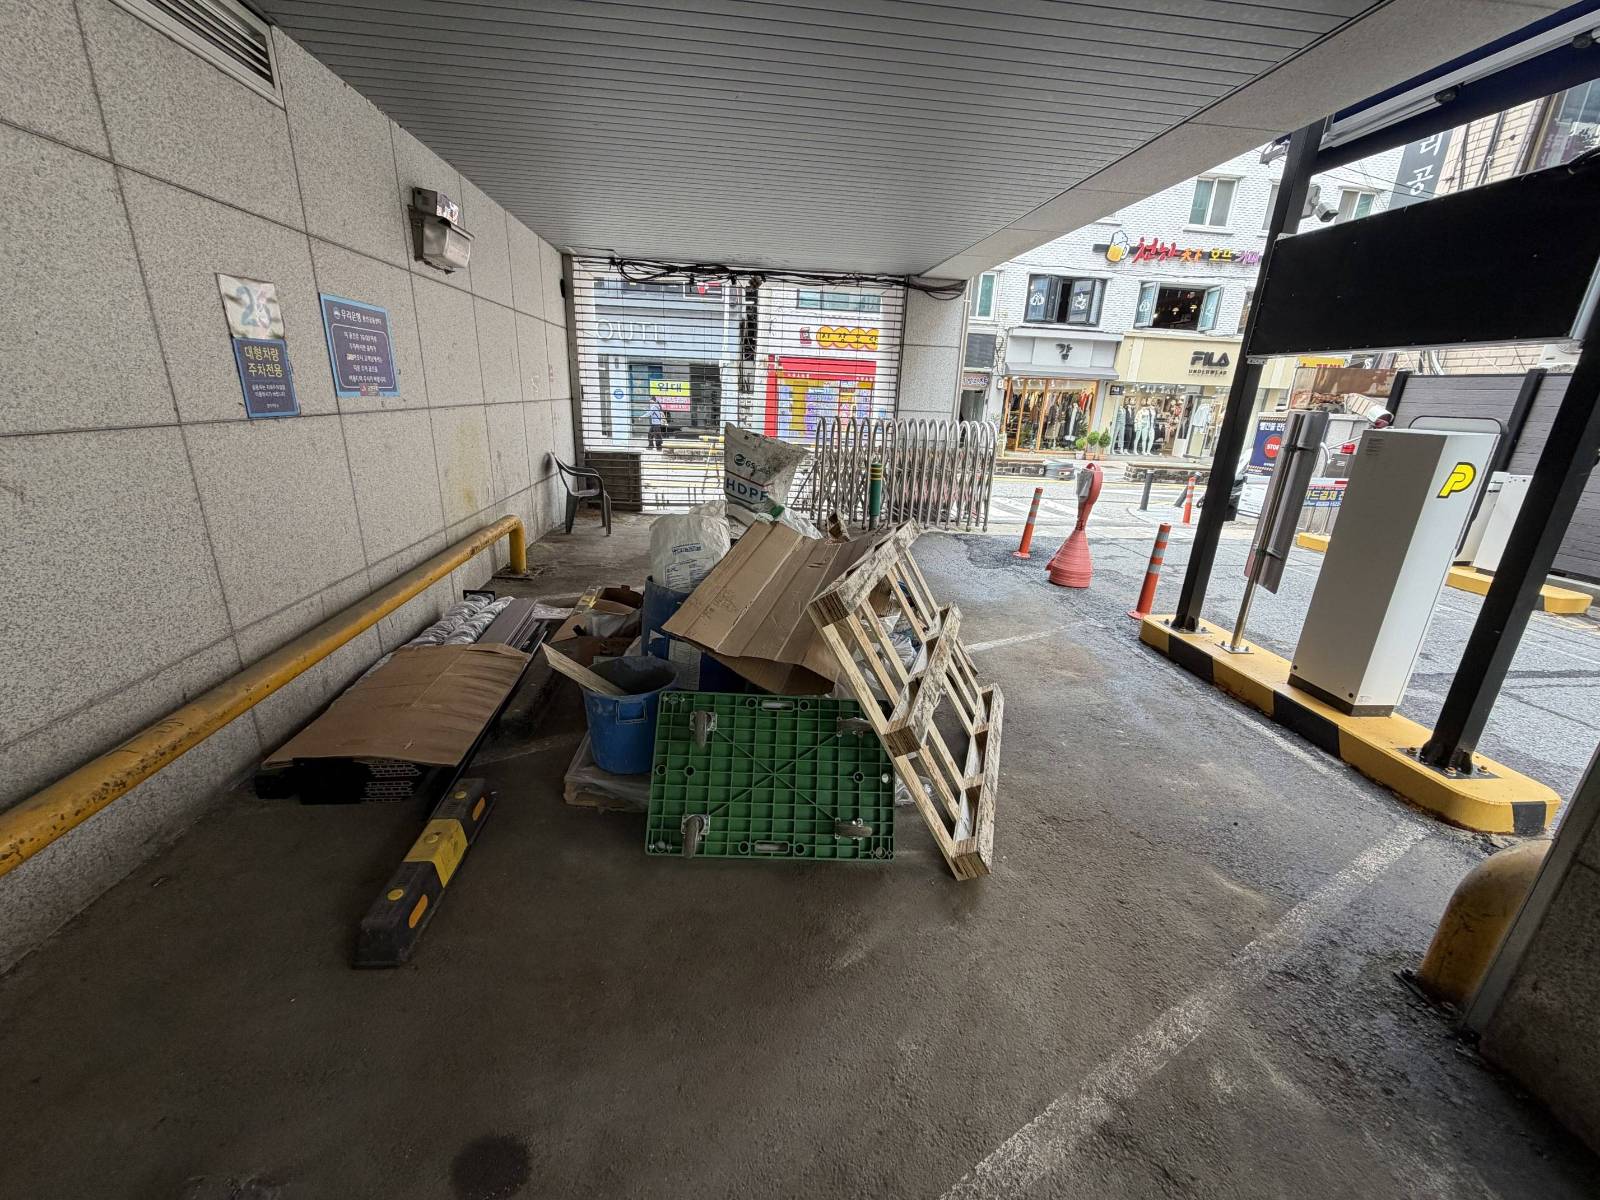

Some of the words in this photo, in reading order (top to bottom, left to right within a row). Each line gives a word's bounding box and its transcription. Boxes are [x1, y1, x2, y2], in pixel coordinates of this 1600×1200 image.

[1209, 248, 1232, 262] 호프
[341, 309, 361, 323] 우리은행
[244, 345, 280, 362] 대형차량
[1190, 350, 1230, 367] FILA
[248, 362, 283, 378] 주차전용
[656, 382, 682, 393] 임대
